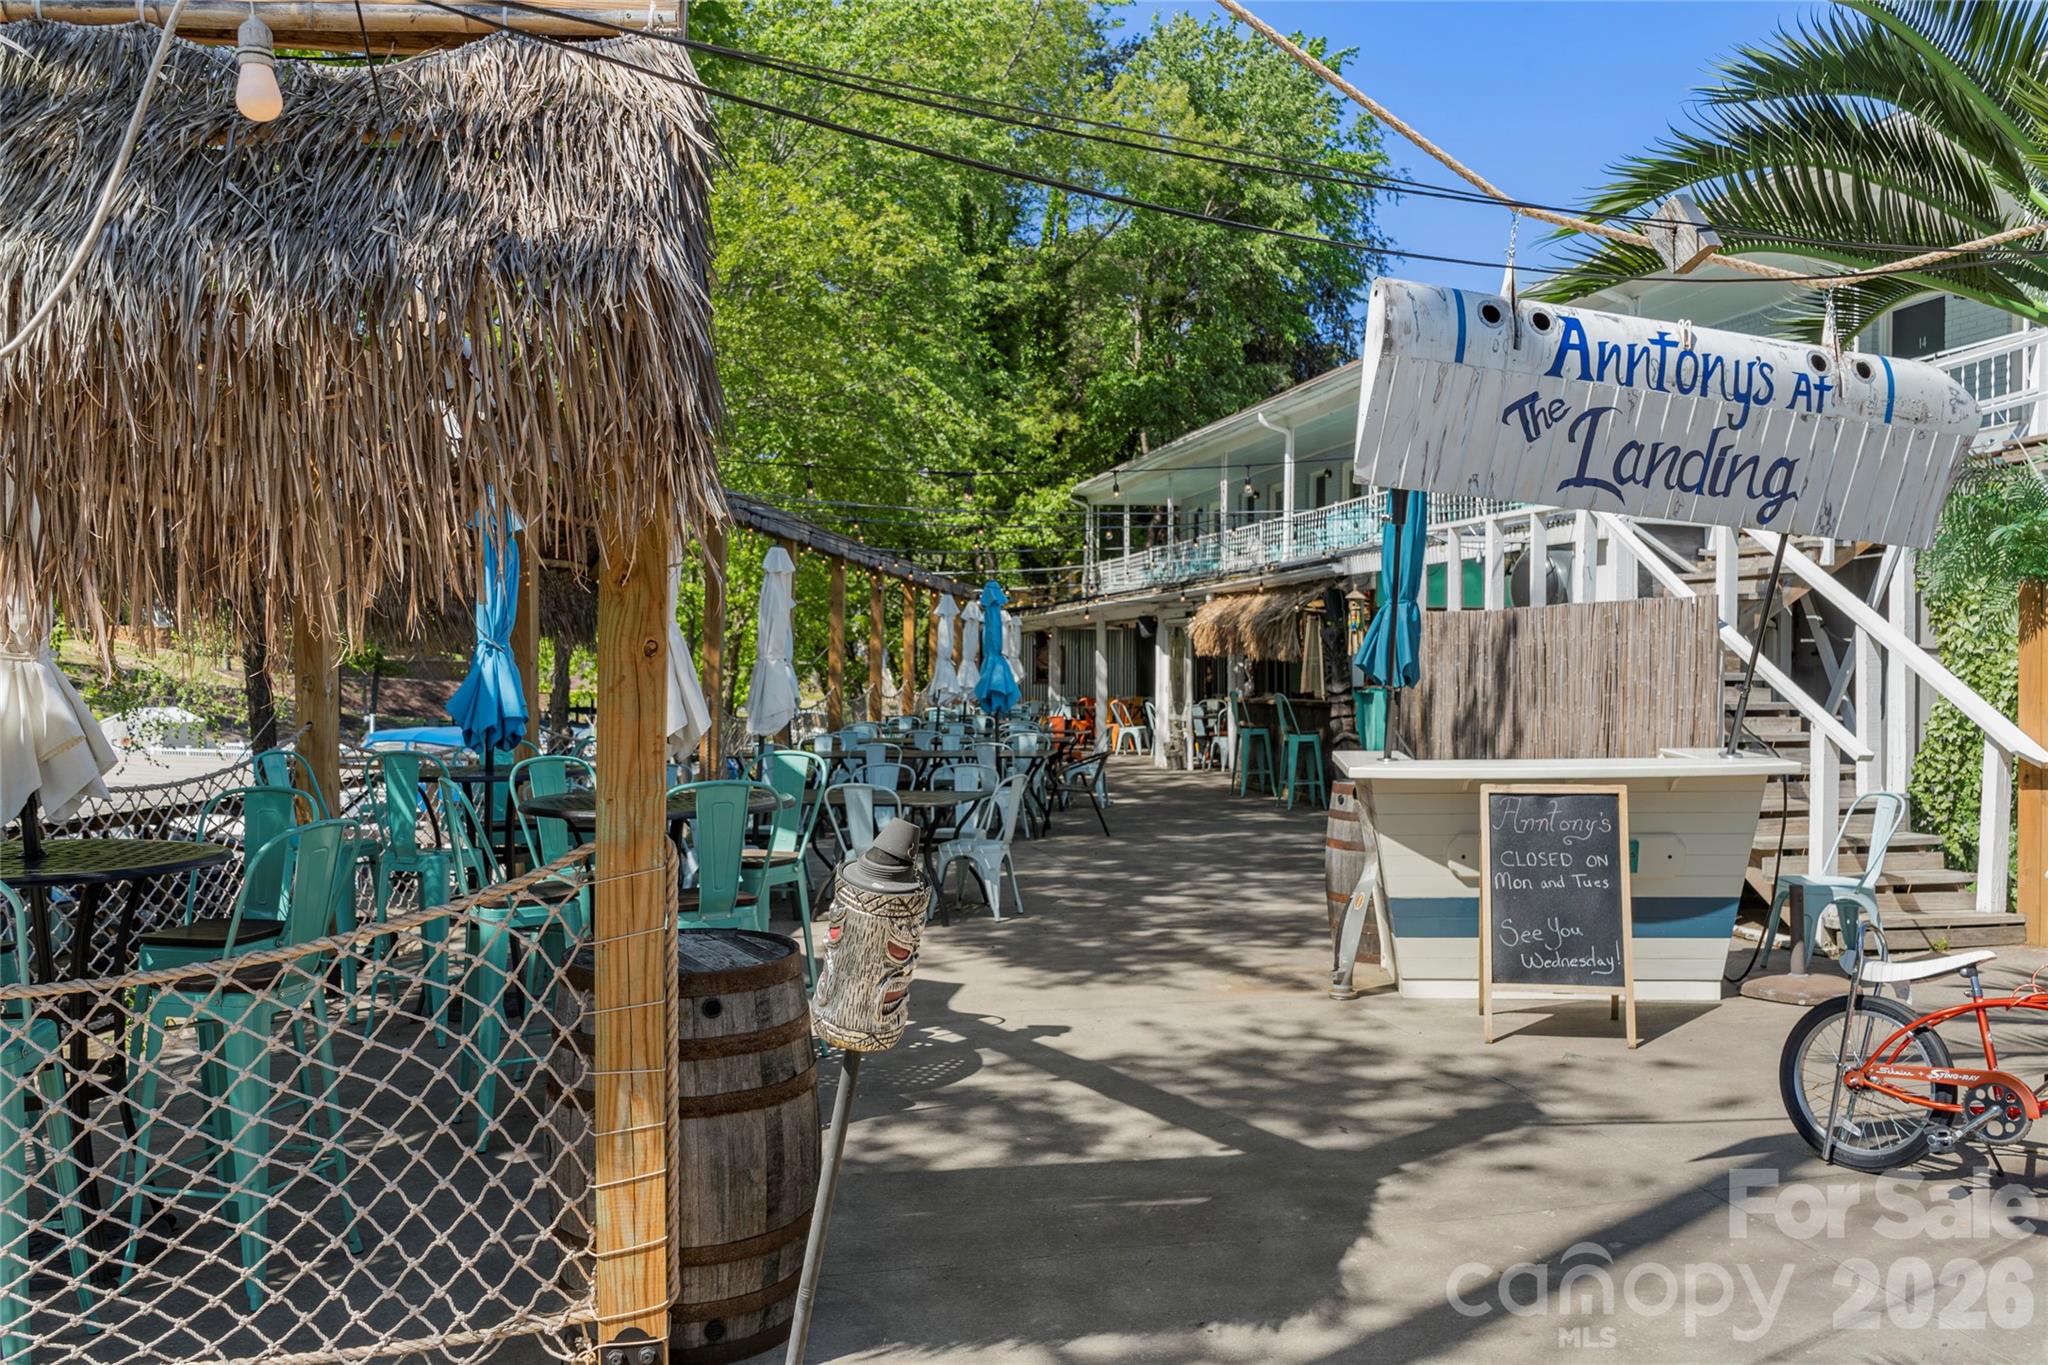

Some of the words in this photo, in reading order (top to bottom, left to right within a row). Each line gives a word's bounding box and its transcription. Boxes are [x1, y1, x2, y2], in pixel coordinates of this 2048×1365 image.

[1544, 316, 1774, 430] Anntony's
[1502, 391, 1571, 443] The
[1556, 406, 1799, 525] Landing
[1492, 796, 1612, 846] Anntony's
[1500, 850, 1573, 868] CLOSED
[1585, 854, 1609, 868] ON
[1494, 871, 1534, 891] Mon
[1540, 874, 1566, 890] and
[1571, 873, 1610, 889] Tues
[1499, 918, 1544, 947] See
[1544, 916, 1584, 951] You
[1520, 940, 1622, 976] Wednesday!
